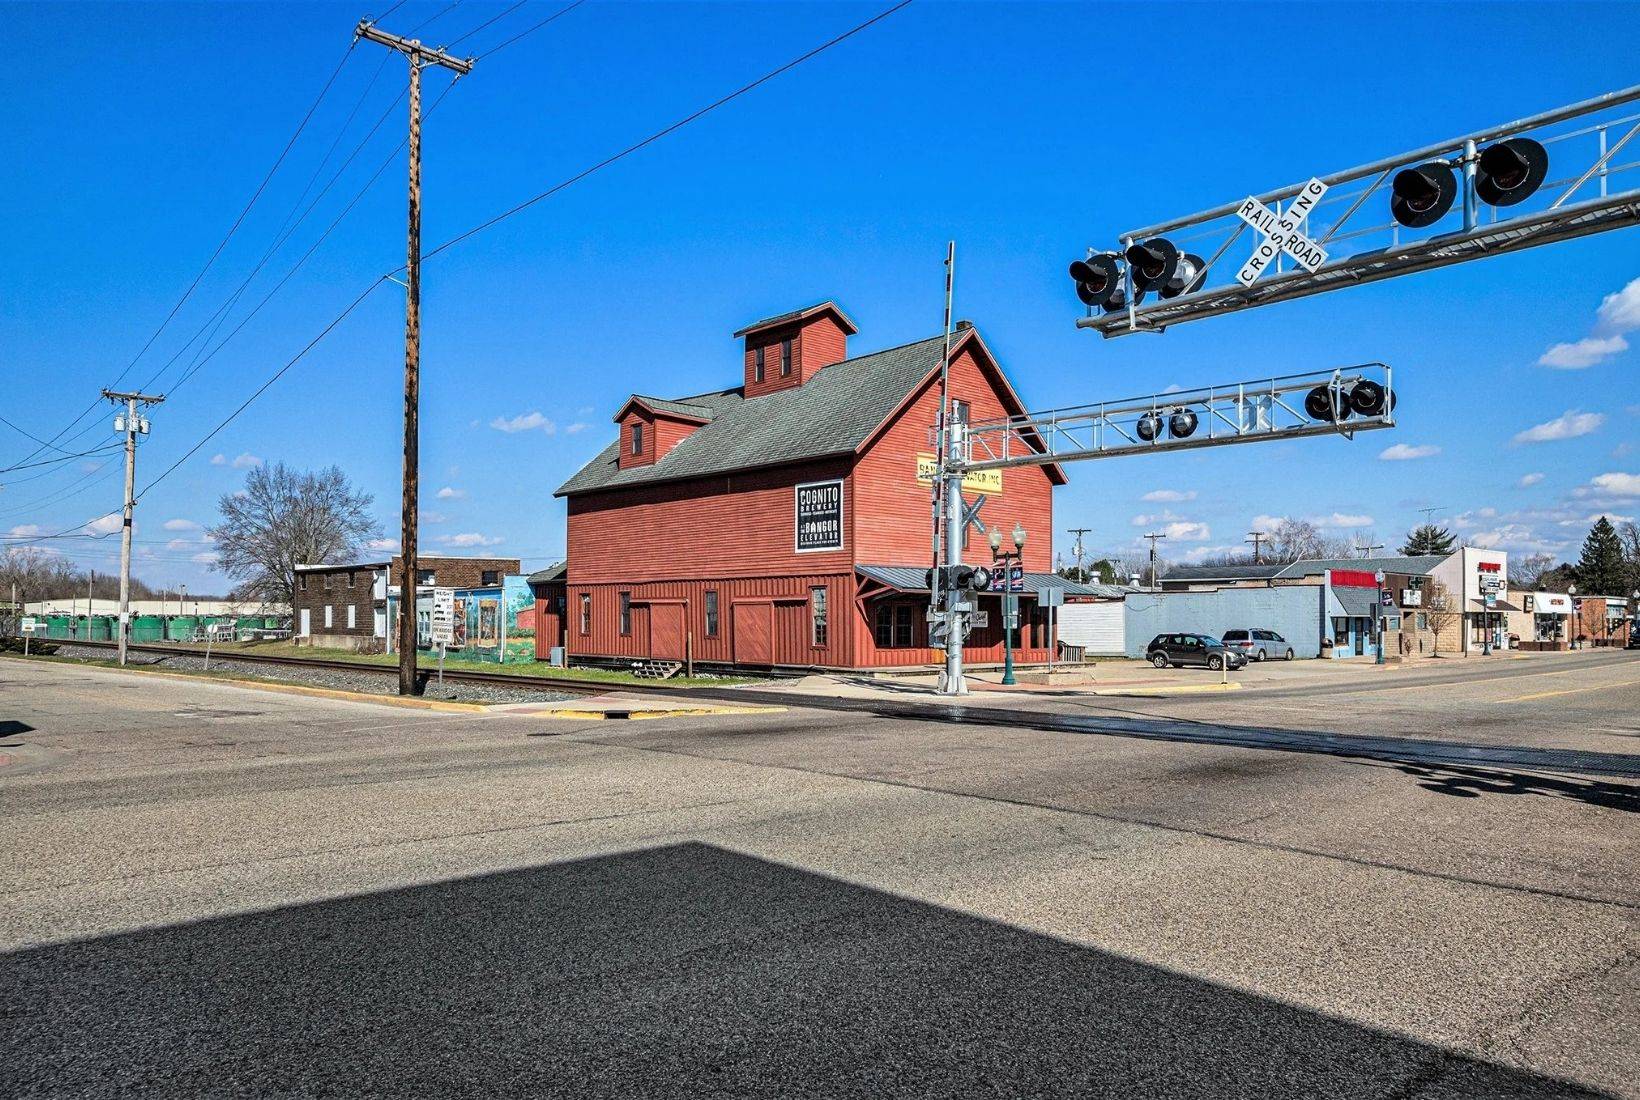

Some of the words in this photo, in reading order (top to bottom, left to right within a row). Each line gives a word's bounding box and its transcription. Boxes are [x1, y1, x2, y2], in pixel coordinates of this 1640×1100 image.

[1241, 182, 1322, 282] CROSSING
[1241, 201, 1274, 234] RAIL
[1284, 235, 1322, 267] ROAD
[800, 487, 838, 505] COGNITO
[800, 502, 838, 512] BREWERY
[805, 520, 838, 533] BANGOR
[800, 532, 838, 542] ELEVATOR
